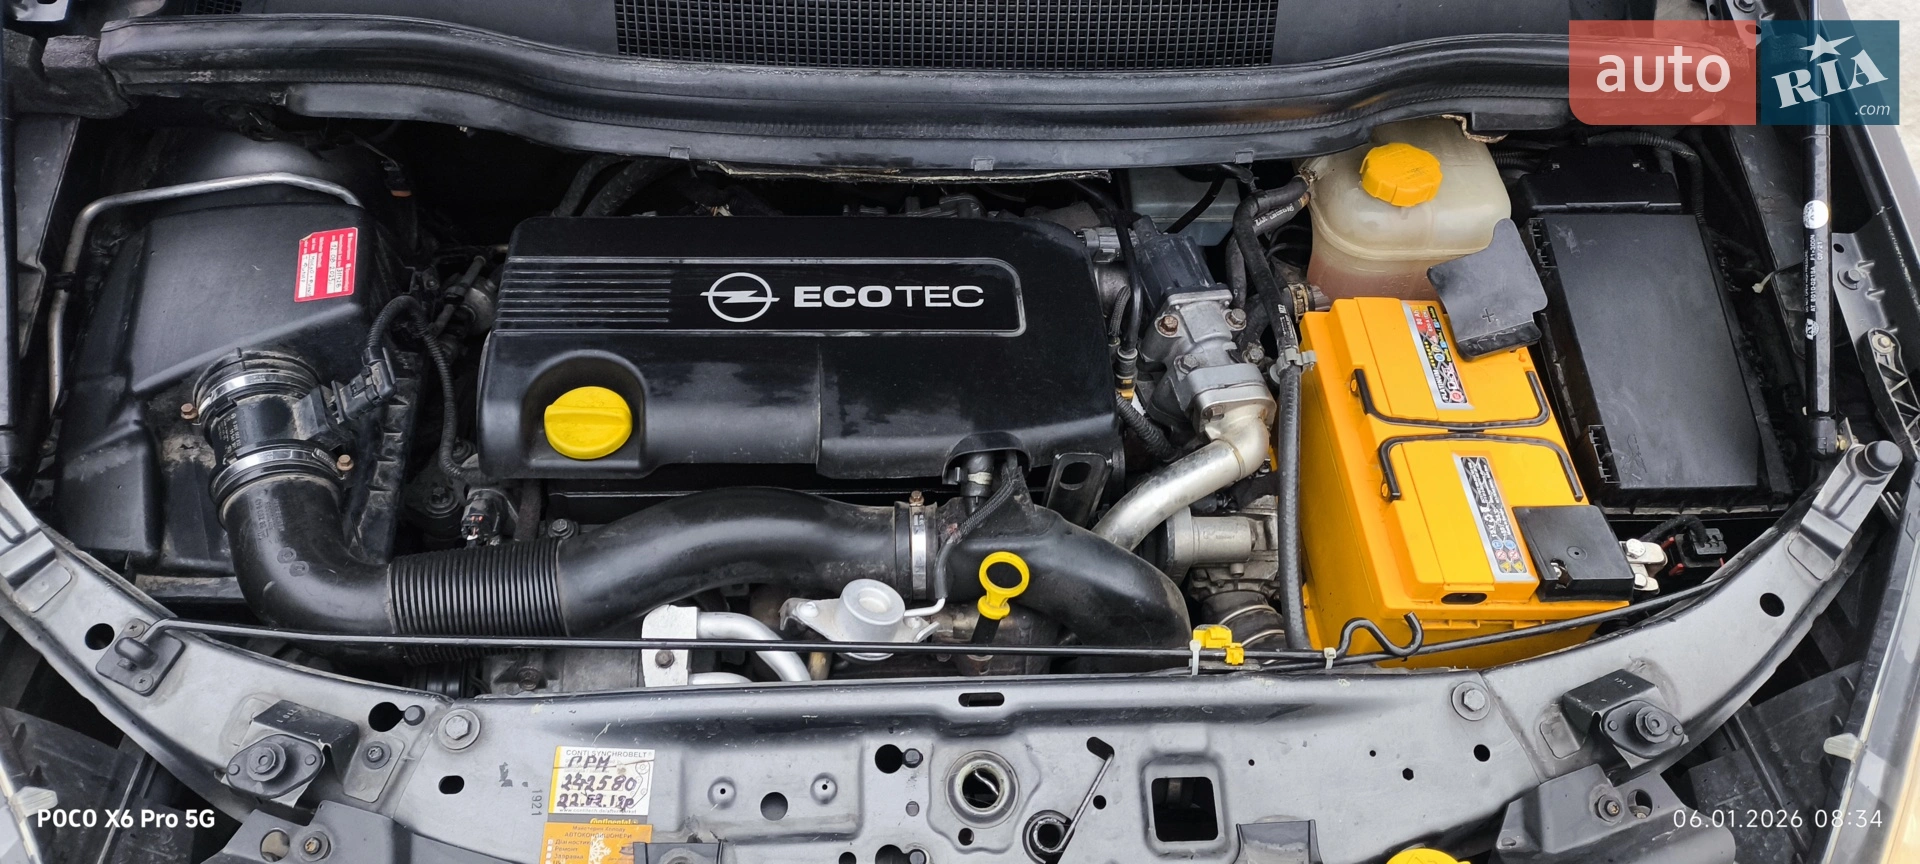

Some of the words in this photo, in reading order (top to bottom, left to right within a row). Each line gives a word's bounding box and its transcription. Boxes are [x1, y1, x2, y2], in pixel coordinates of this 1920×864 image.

[794, 285, 985, 308] ECOTEC
[1433, 369, 1449, 401] PLATINUM
[566, 749, 590, 757] CONTI
[561, 771, 637, 792] 242580
[531, 789, 543, 816] 1921
